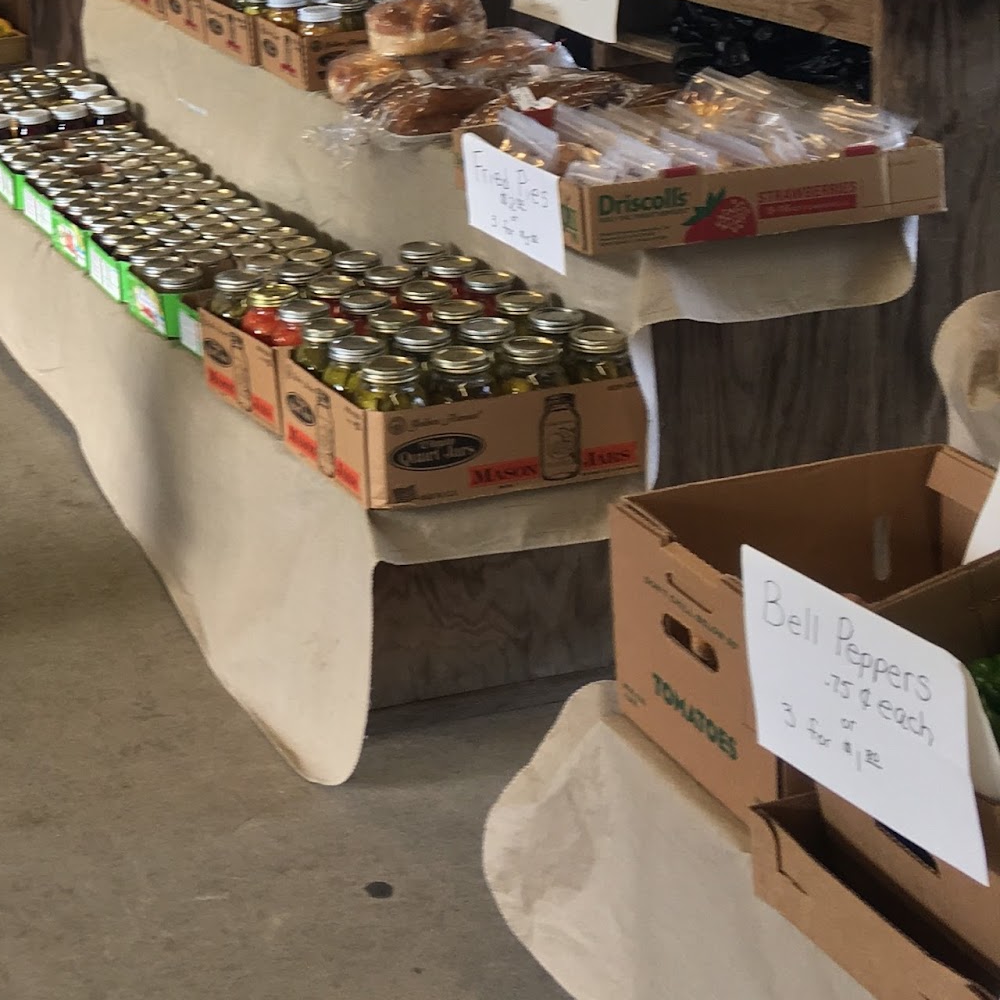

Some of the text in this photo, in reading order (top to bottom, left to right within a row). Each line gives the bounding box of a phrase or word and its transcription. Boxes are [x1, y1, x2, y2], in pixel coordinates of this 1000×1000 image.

[472, 460, 539, 487] MASON
[582, 446, 634, 468] JARS
[762, 580, 932, 702] Bell Peppers
[781, 701, 797, 728] 3
[806, 717, 832, 748] for
[877, 699, 935, 747] each
